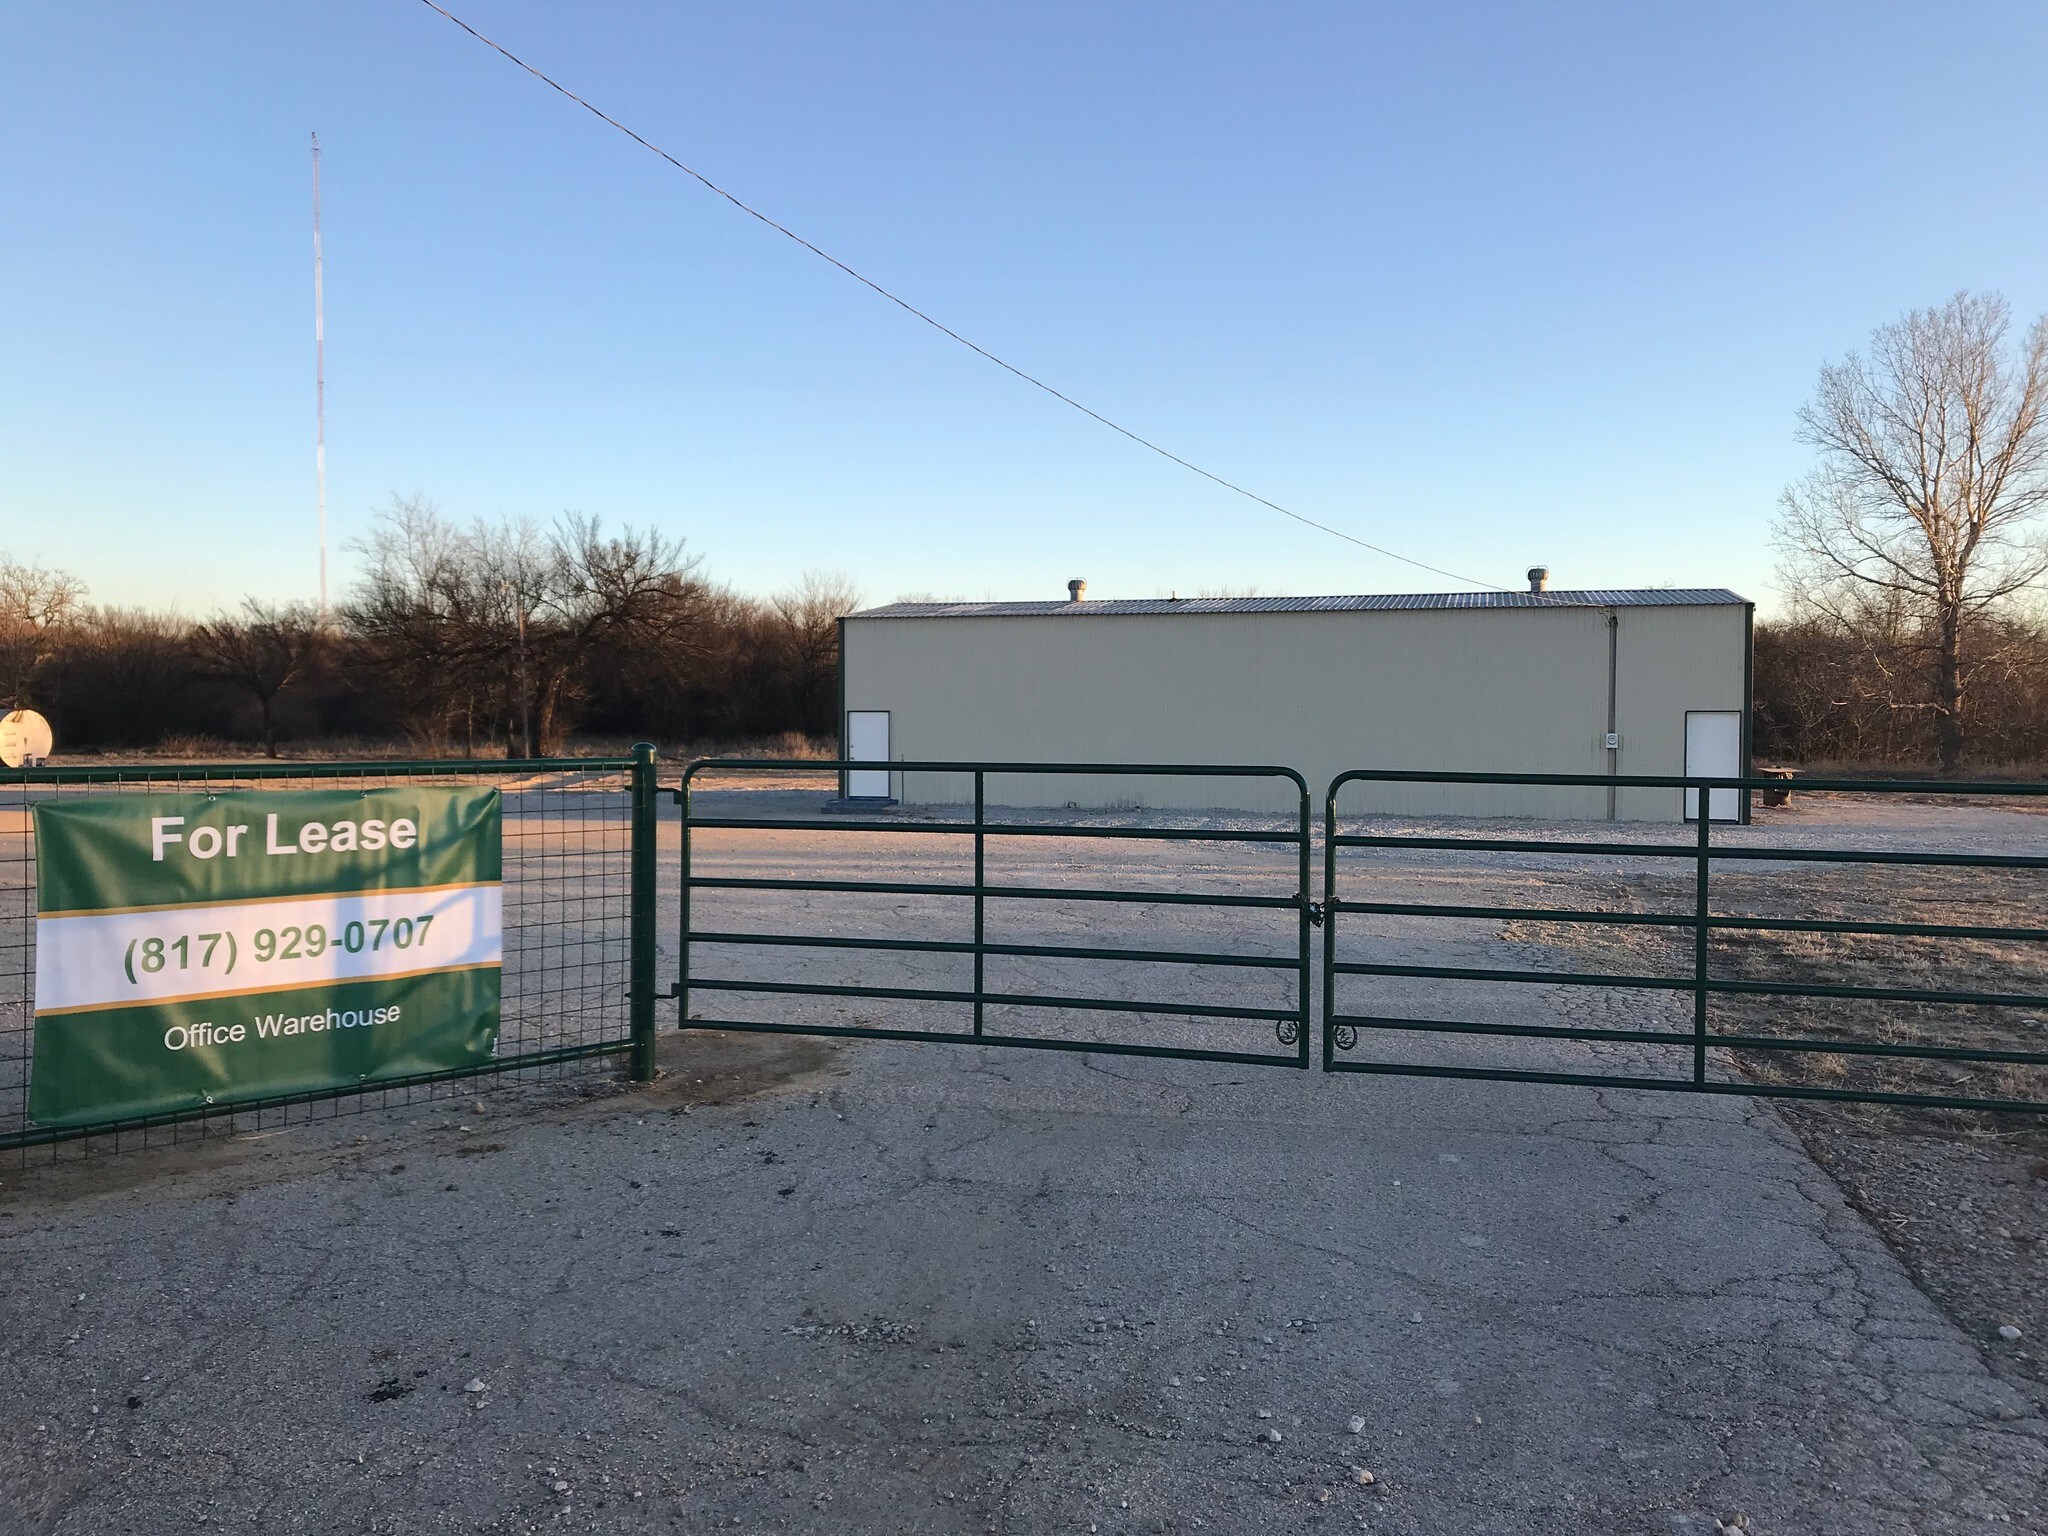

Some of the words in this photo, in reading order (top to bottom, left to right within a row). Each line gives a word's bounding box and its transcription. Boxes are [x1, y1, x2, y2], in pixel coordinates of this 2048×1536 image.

[152, 816, 248, 861] For
[266, 813, 417, 855] Lease
[124, 931, 238, 984] (817)
[253, 915, 434, 962] 929-0707
[164, 1022, 246, 1051] Office
[254, 1004, 400, 1038] Warehouse
